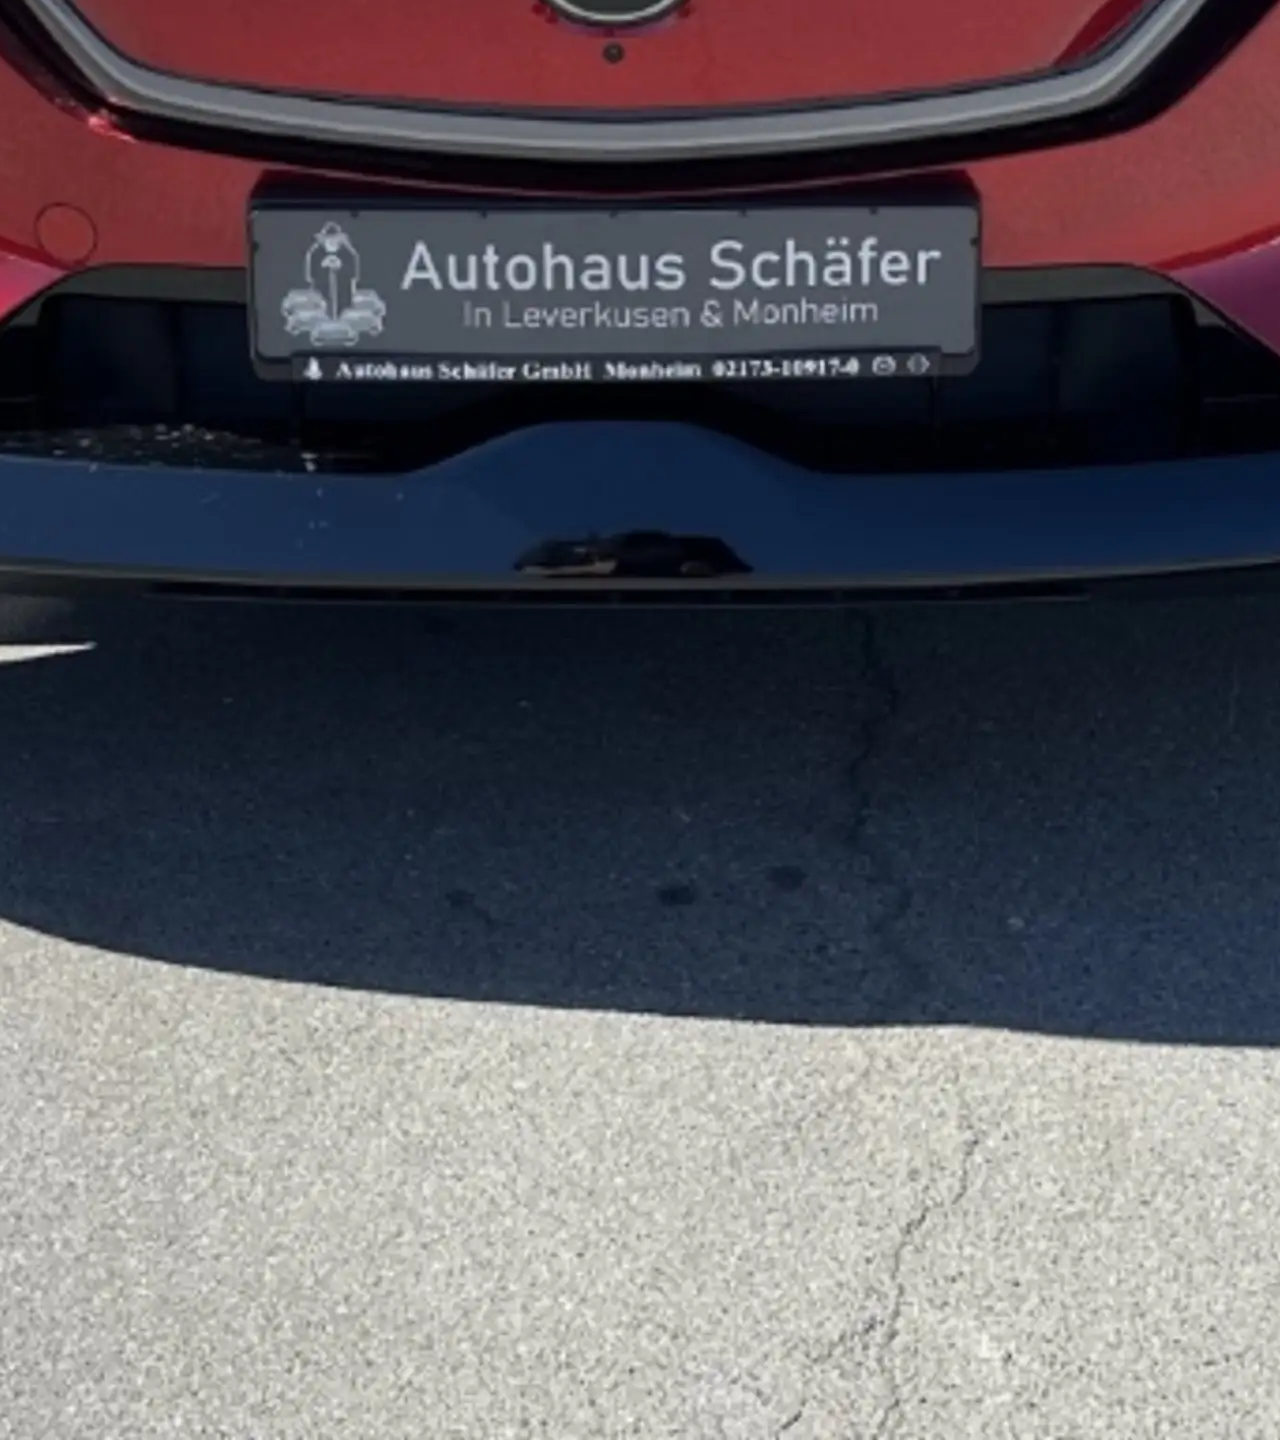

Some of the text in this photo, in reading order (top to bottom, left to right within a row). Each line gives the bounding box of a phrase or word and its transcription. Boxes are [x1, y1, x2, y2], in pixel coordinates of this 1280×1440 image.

[400, 236, 942, 291] Autohaus Schäfer
[463, 295, 879, 328] In Leverkusen & Monheim
[335, 361, 433, 381] Autohaus
[437, 360, 517, 381] Schäfer
[522, 360, 592, 381] GmbH
[603, 360, 703, 380] Monheim
